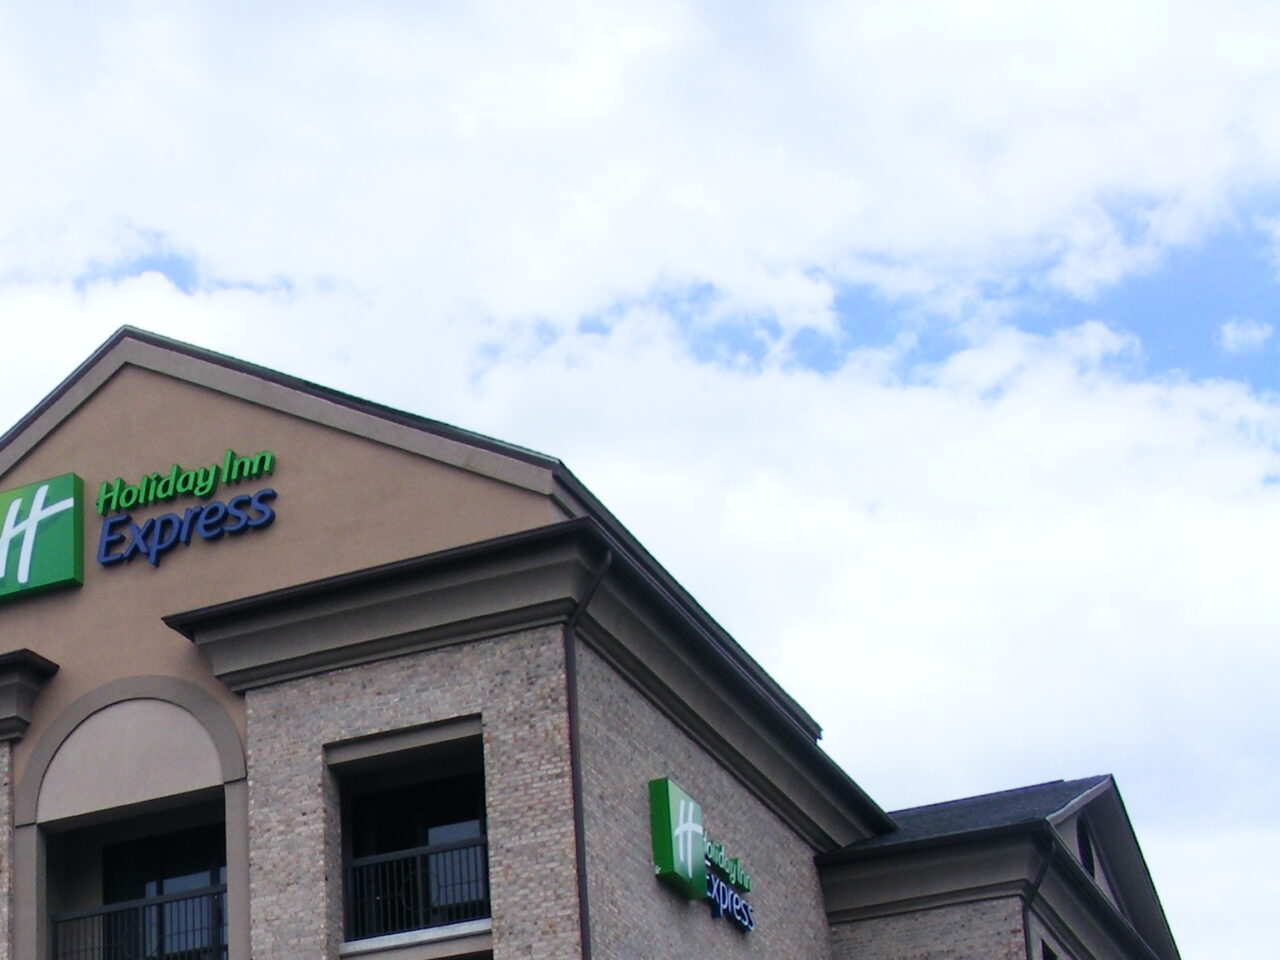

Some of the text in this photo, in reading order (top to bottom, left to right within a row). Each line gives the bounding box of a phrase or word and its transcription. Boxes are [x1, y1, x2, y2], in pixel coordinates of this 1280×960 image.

[96, 449, 275, 516] Holiday Inn
[97, 488, 277, 567] Express
